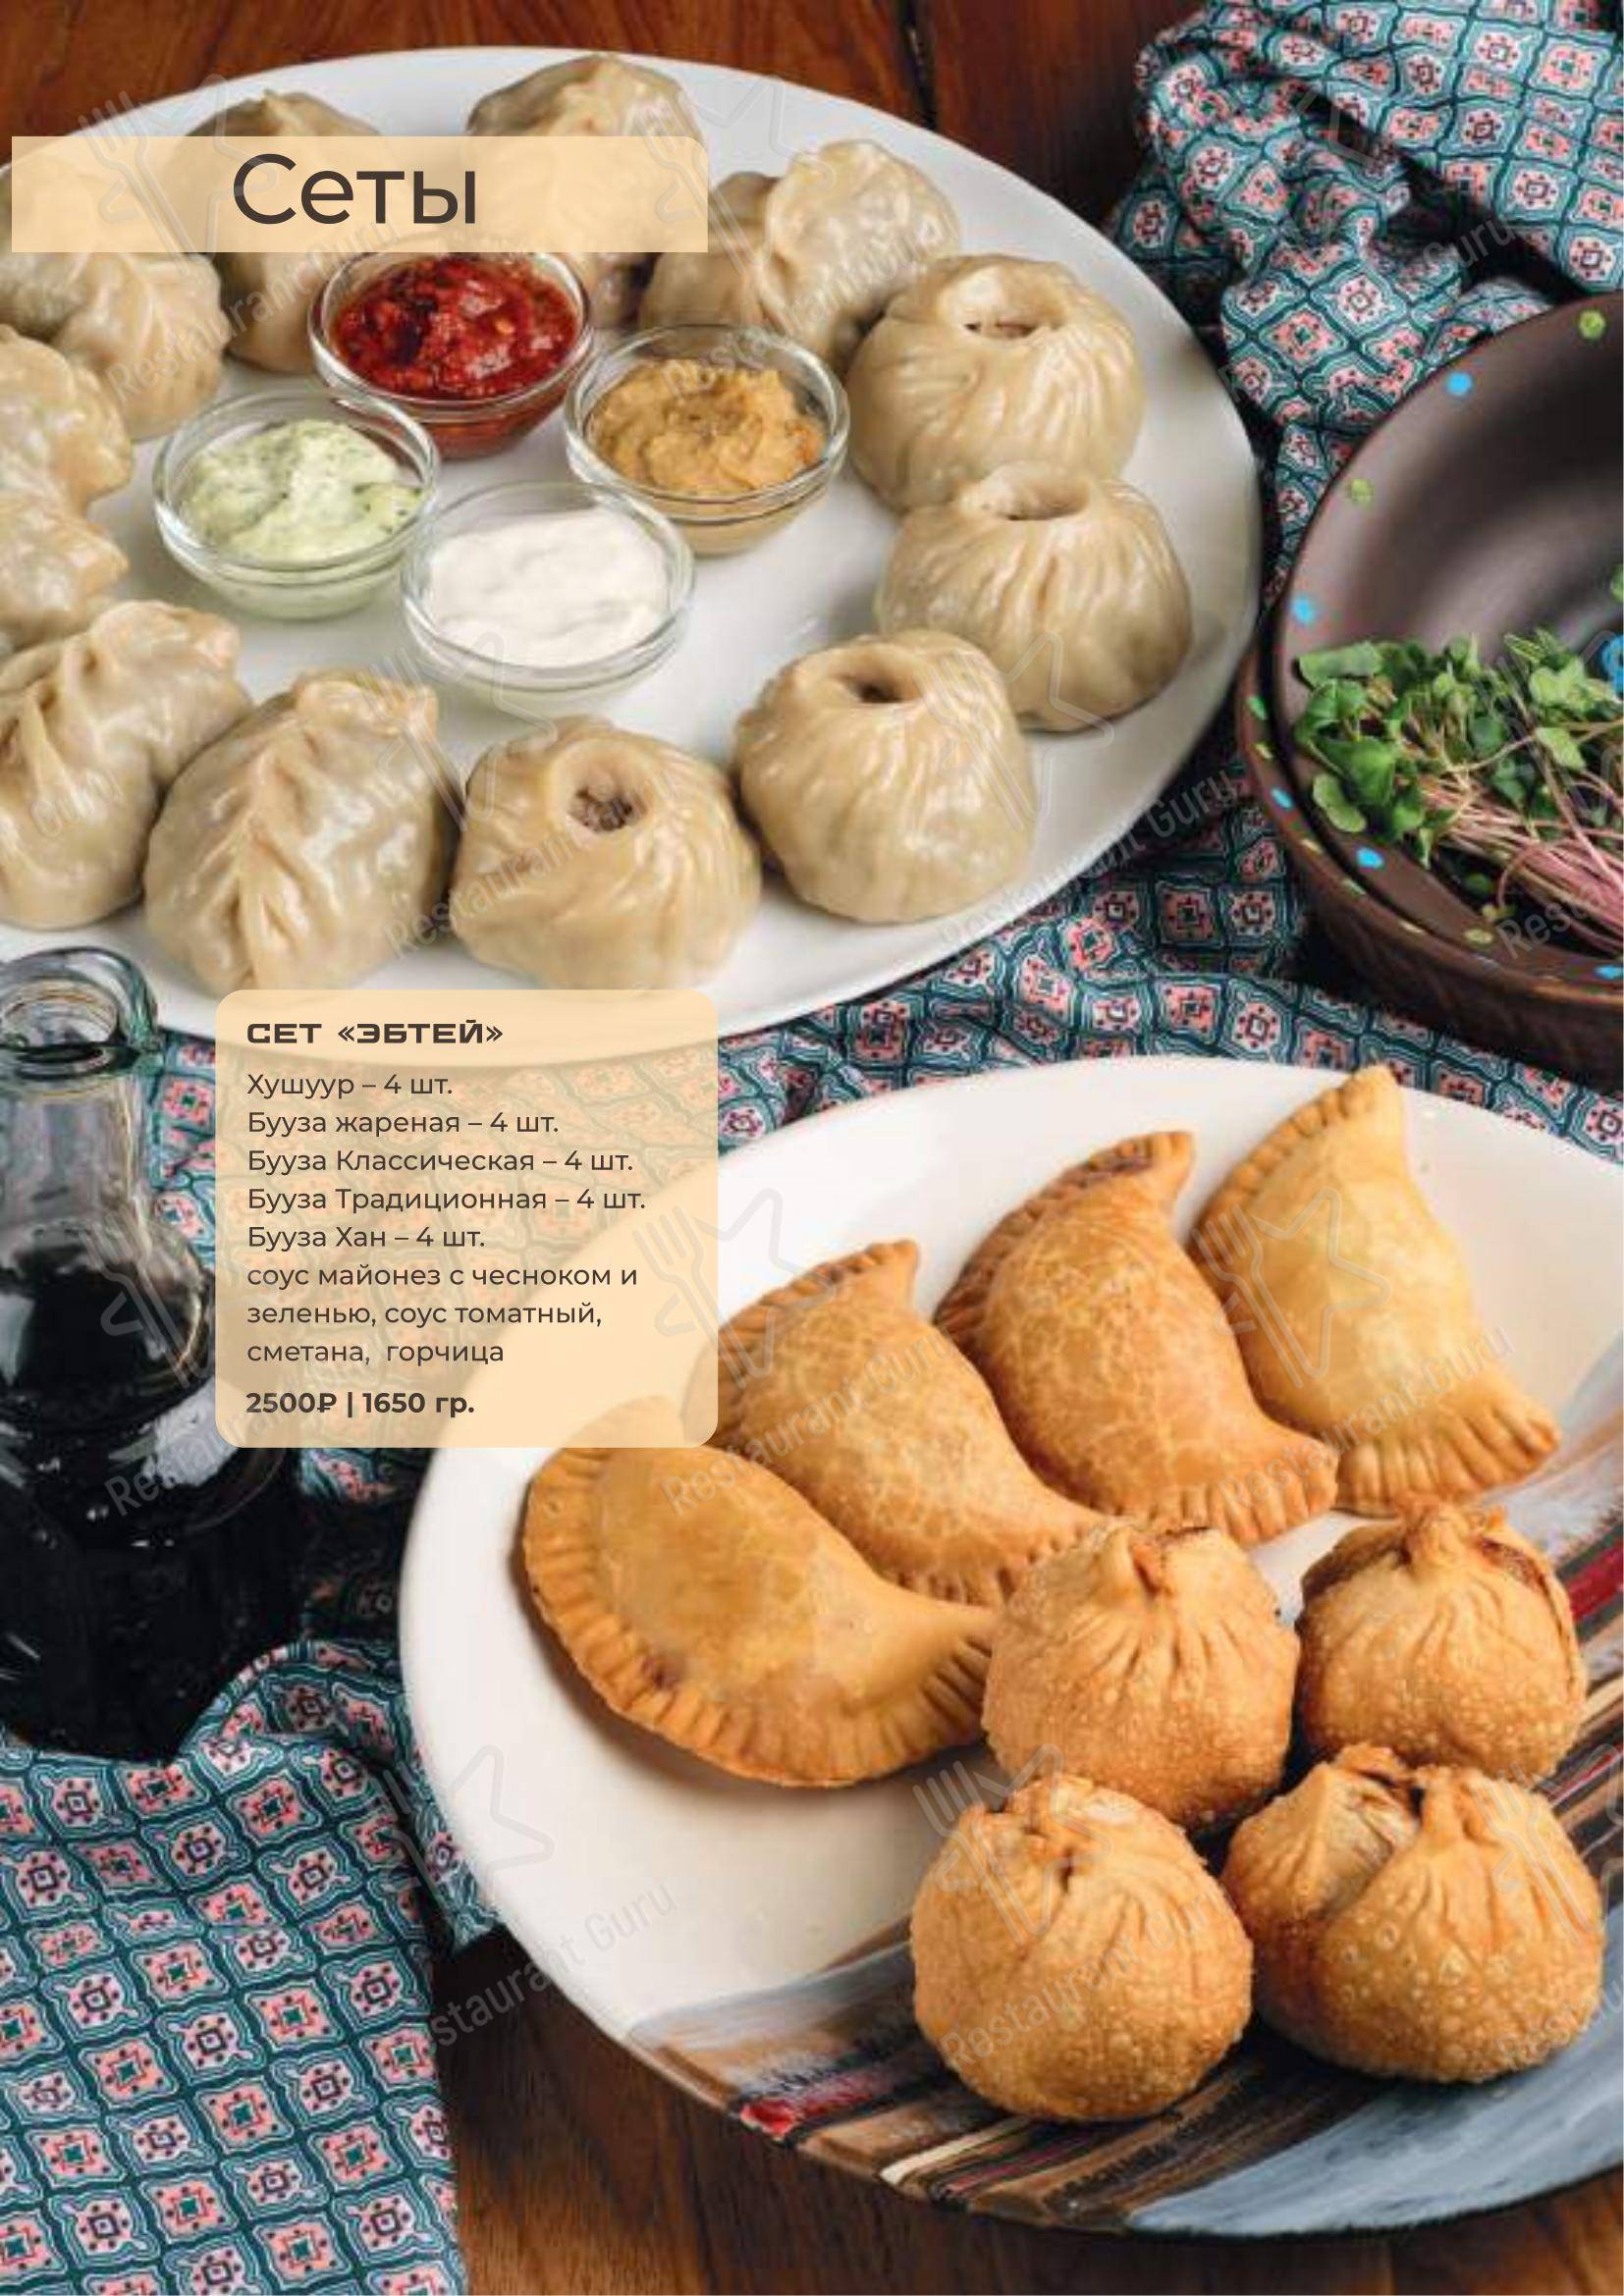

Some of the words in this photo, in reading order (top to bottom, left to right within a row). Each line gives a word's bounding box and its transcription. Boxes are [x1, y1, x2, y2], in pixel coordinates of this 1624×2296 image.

[233, 153, 475, 225] Сеты
[246, 1023, 322, 1043] СЕТ
[338, 1019, 504, 1043] «ЭБТЕЙ»
[246, 1074, 354, 1099] Хушуур
[383, 1074, 402, 1095] 4
[410, 1078, 453, 1095] шт.
[248, 1111, 326, 1138] Бууза
[336, 1116, 460, 1138] жареная
[490, 1112, 509, 1133] 4
[516, 1116, 559, 1133] шт.
[248, 1149, 326, 1176] Бууза
[337, 1149, 534, 1171] Классическая
[564, 1149, 582, 1171] 4
[591, 1154, 633, 1171] шт.
[248, 1188, 326, 1214] Бууза
[335, 1188, 546, 1214] Традиционная
[576, 1188, 595, 1209] 4
[604, 1193, 645, 1209] шт.
[248, 1226, 326, 1253] Бууза
[336, 1226, 386, 1248] Хан
[415, 1226, 434, 1247] 4
[443, 1231, 485, 1248] шт.
[247, 1269, 309, 1291] соус
[319, 1263, 441, 1286] майонез
[450, 1269, 464, 1286] с
[472, 1269, 611, 1286] чесноком
[622, 1269, 637, 1285] и
[247, 1307, 376, 1327] зеленью,
[385, 1308, 447, 1329] соус
[454, 1302, 602, 1327] томатный,
[246, 1345, 370, 1365] сметана,
[387, 1346, 504, 1366] горчица
[362, 1392, 426, 1414] 1650
[436, 1397, 474, 1418] гр.
